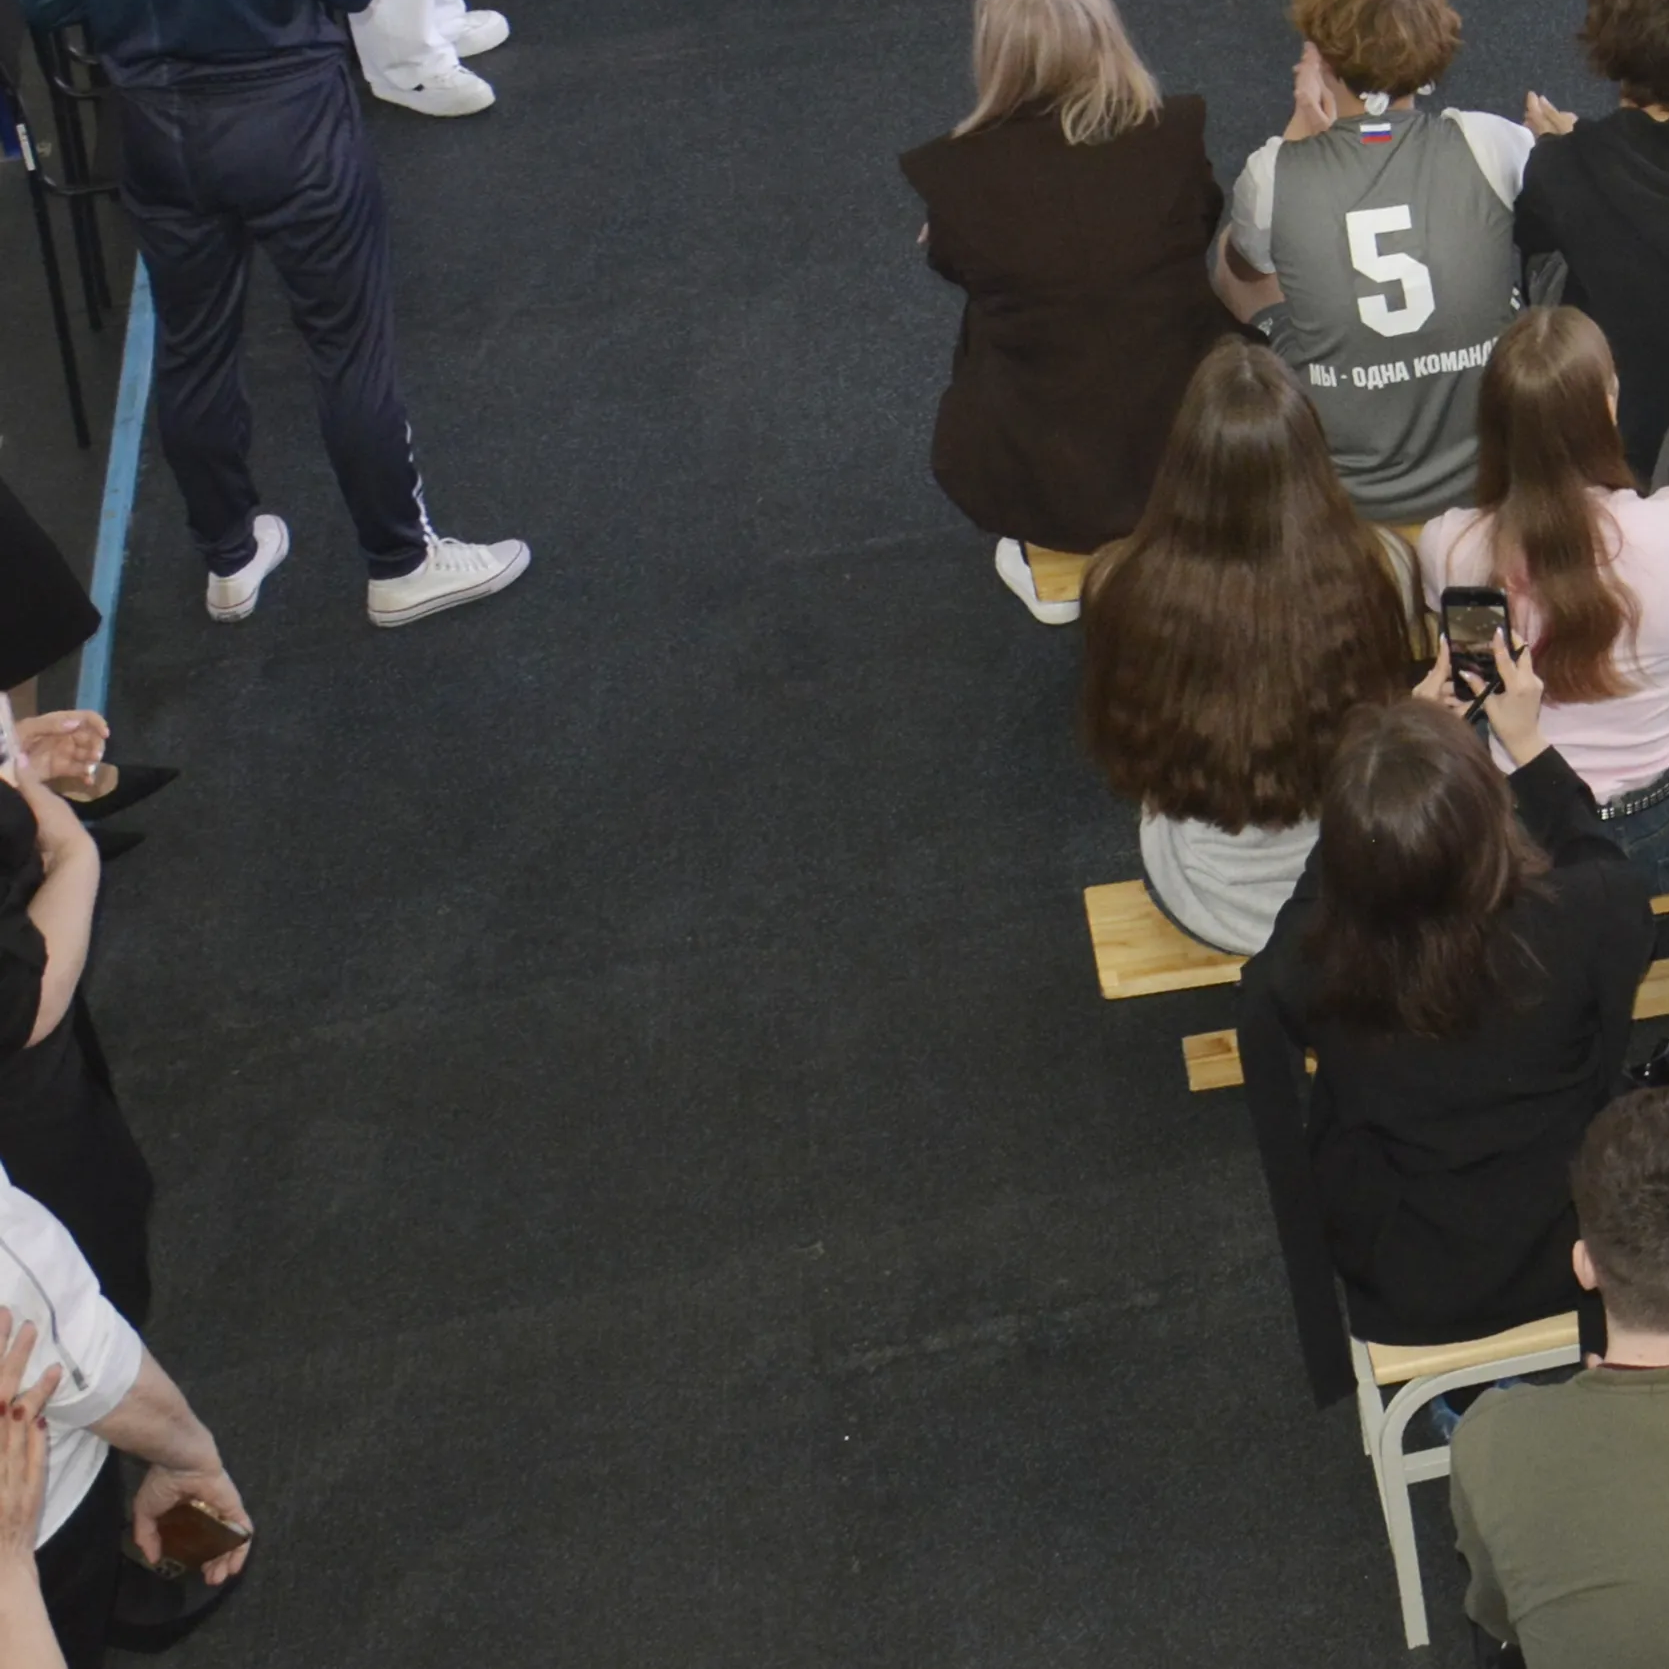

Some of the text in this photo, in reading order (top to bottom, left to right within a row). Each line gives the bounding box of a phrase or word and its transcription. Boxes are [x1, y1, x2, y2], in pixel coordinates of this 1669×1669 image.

[1346, 204, 1436, 338] 5
[1351, 361, 1400, 391] ОДНА
[1413, 336, 1499, 379] КОМАНД
